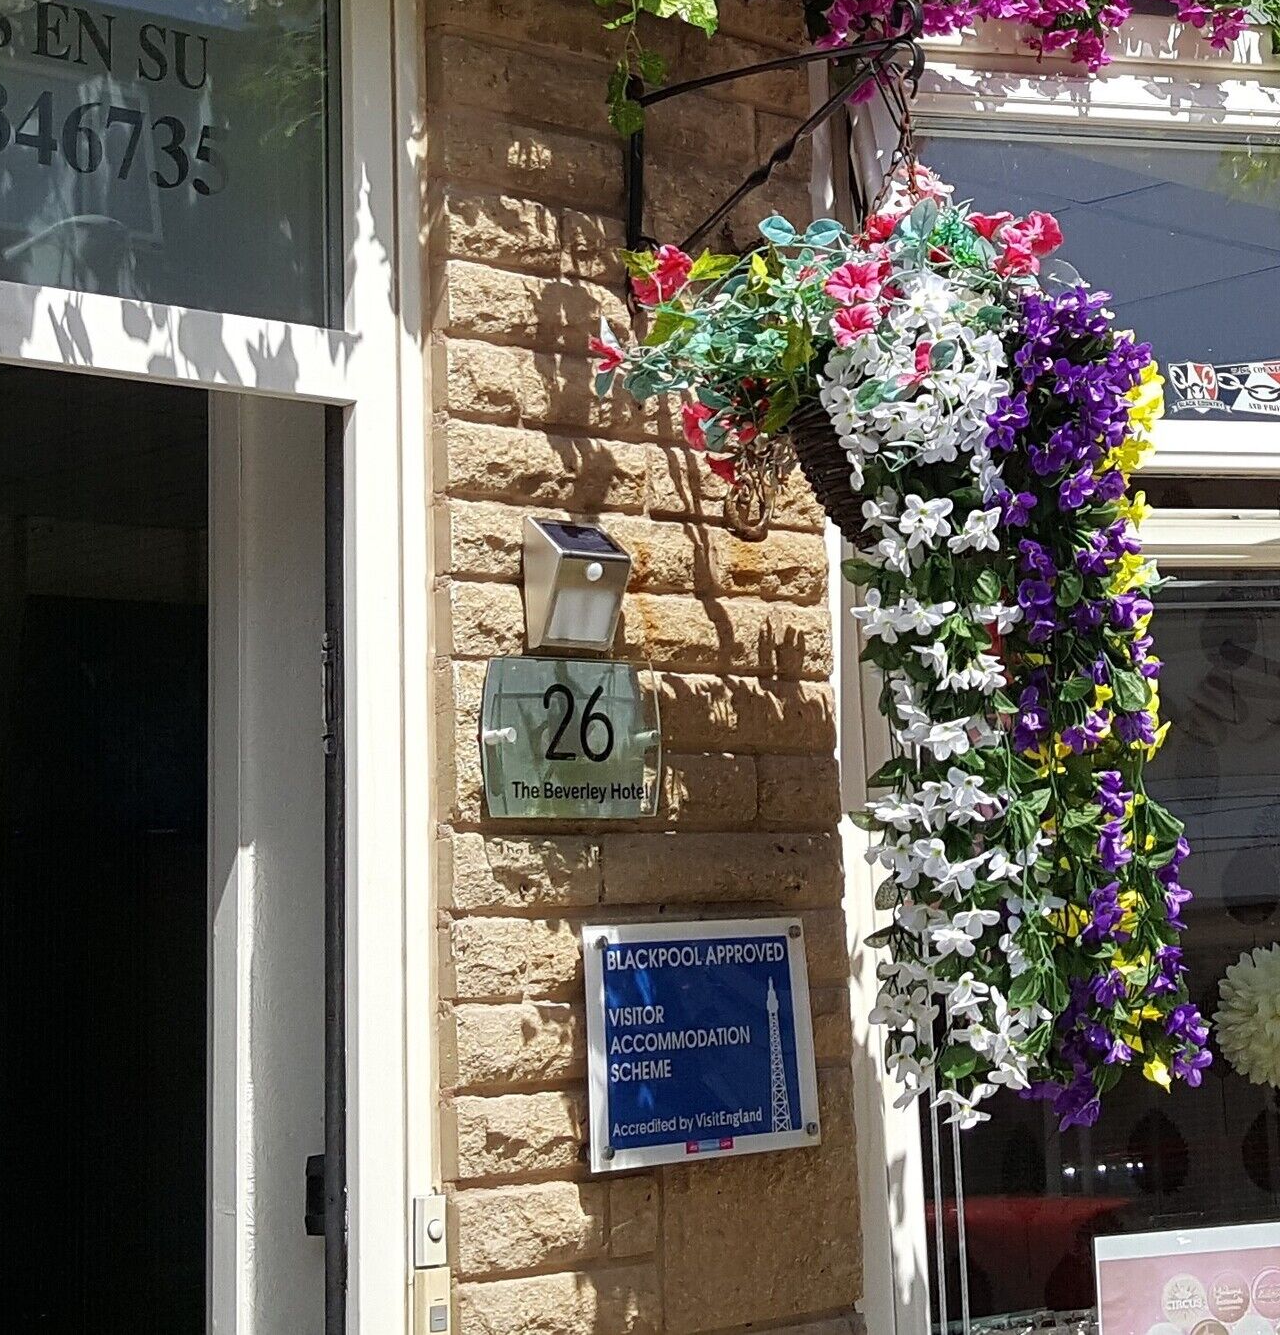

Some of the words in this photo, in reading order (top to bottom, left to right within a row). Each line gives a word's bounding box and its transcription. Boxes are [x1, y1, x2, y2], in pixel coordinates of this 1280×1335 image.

[543, 683, 615, 763] 26
[512, 781, 540, 799] The
[543, 782, 607, 804] Beverley
[611, 783, 649, 800] Hotel
[606, 946, 702, 971] BLACKPOOL
[706, 942, 785, 966] APPROVED
[608, 1005, 665, 1027] VISITOR
[610, 1026, 751, 1055] ACCOMMODATION
[610, 1059, 672, 1083] SCHEME
[612, 1117, 677, 1137] Accredited
[679, 1116, 695, 1133] by
[695, 1106, 763, 1128] VisitEngland
